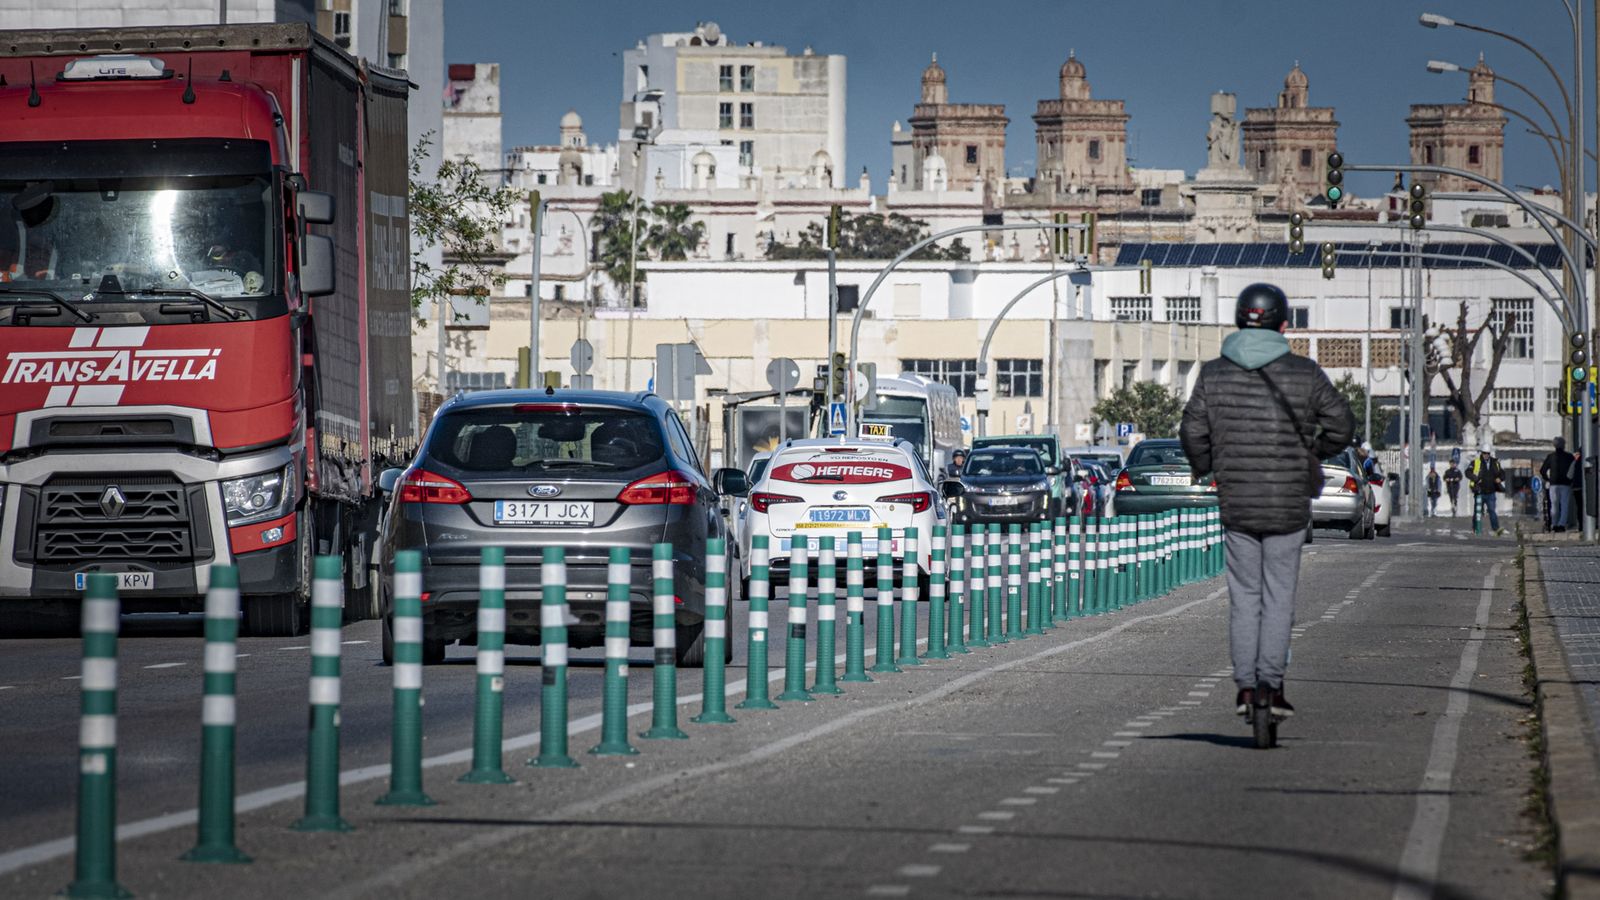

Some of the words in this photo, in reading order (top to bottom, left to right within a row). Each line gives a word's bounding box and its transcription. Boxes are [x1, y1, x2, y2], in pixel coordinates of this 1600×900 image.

[98, 67, 127, 75] LITE
[868, 424, 887, 436] TAXI
[1121, 425, 1129, 437] P
[816, 464, 893, 478] HEMEGAS
[508, 503, 549, 518] 3171
[558, 504, 590, 518] JCX
[818, 510, 844, 521] 1972
[847, 510, 868, 521] MLX
[124, 574, 150, 588] KPV
